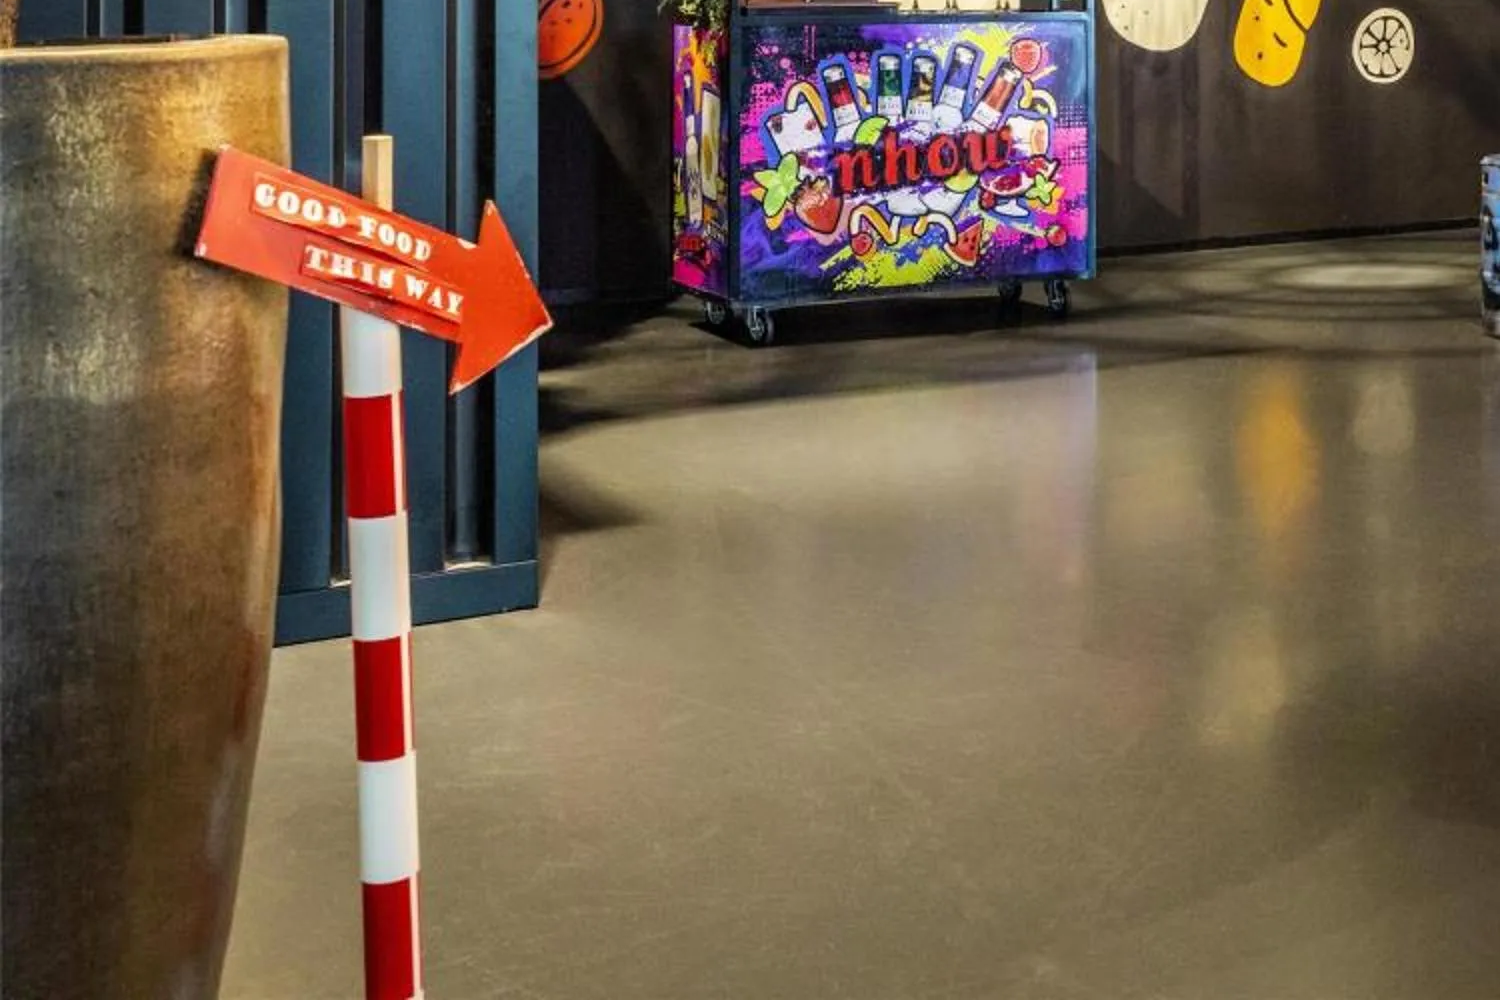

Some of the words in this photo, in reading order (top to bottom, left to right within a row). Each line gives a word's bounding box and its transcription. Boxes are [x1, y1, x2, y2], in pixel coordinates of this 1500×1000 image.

[833, 126, 1013, 193] nhow
[253, 182, 348, 228] GOOD
[356, 214, 433, 262] FOOD
[303, 244, 396, 289] THIS
[404, 274, 465, 316] WAY
